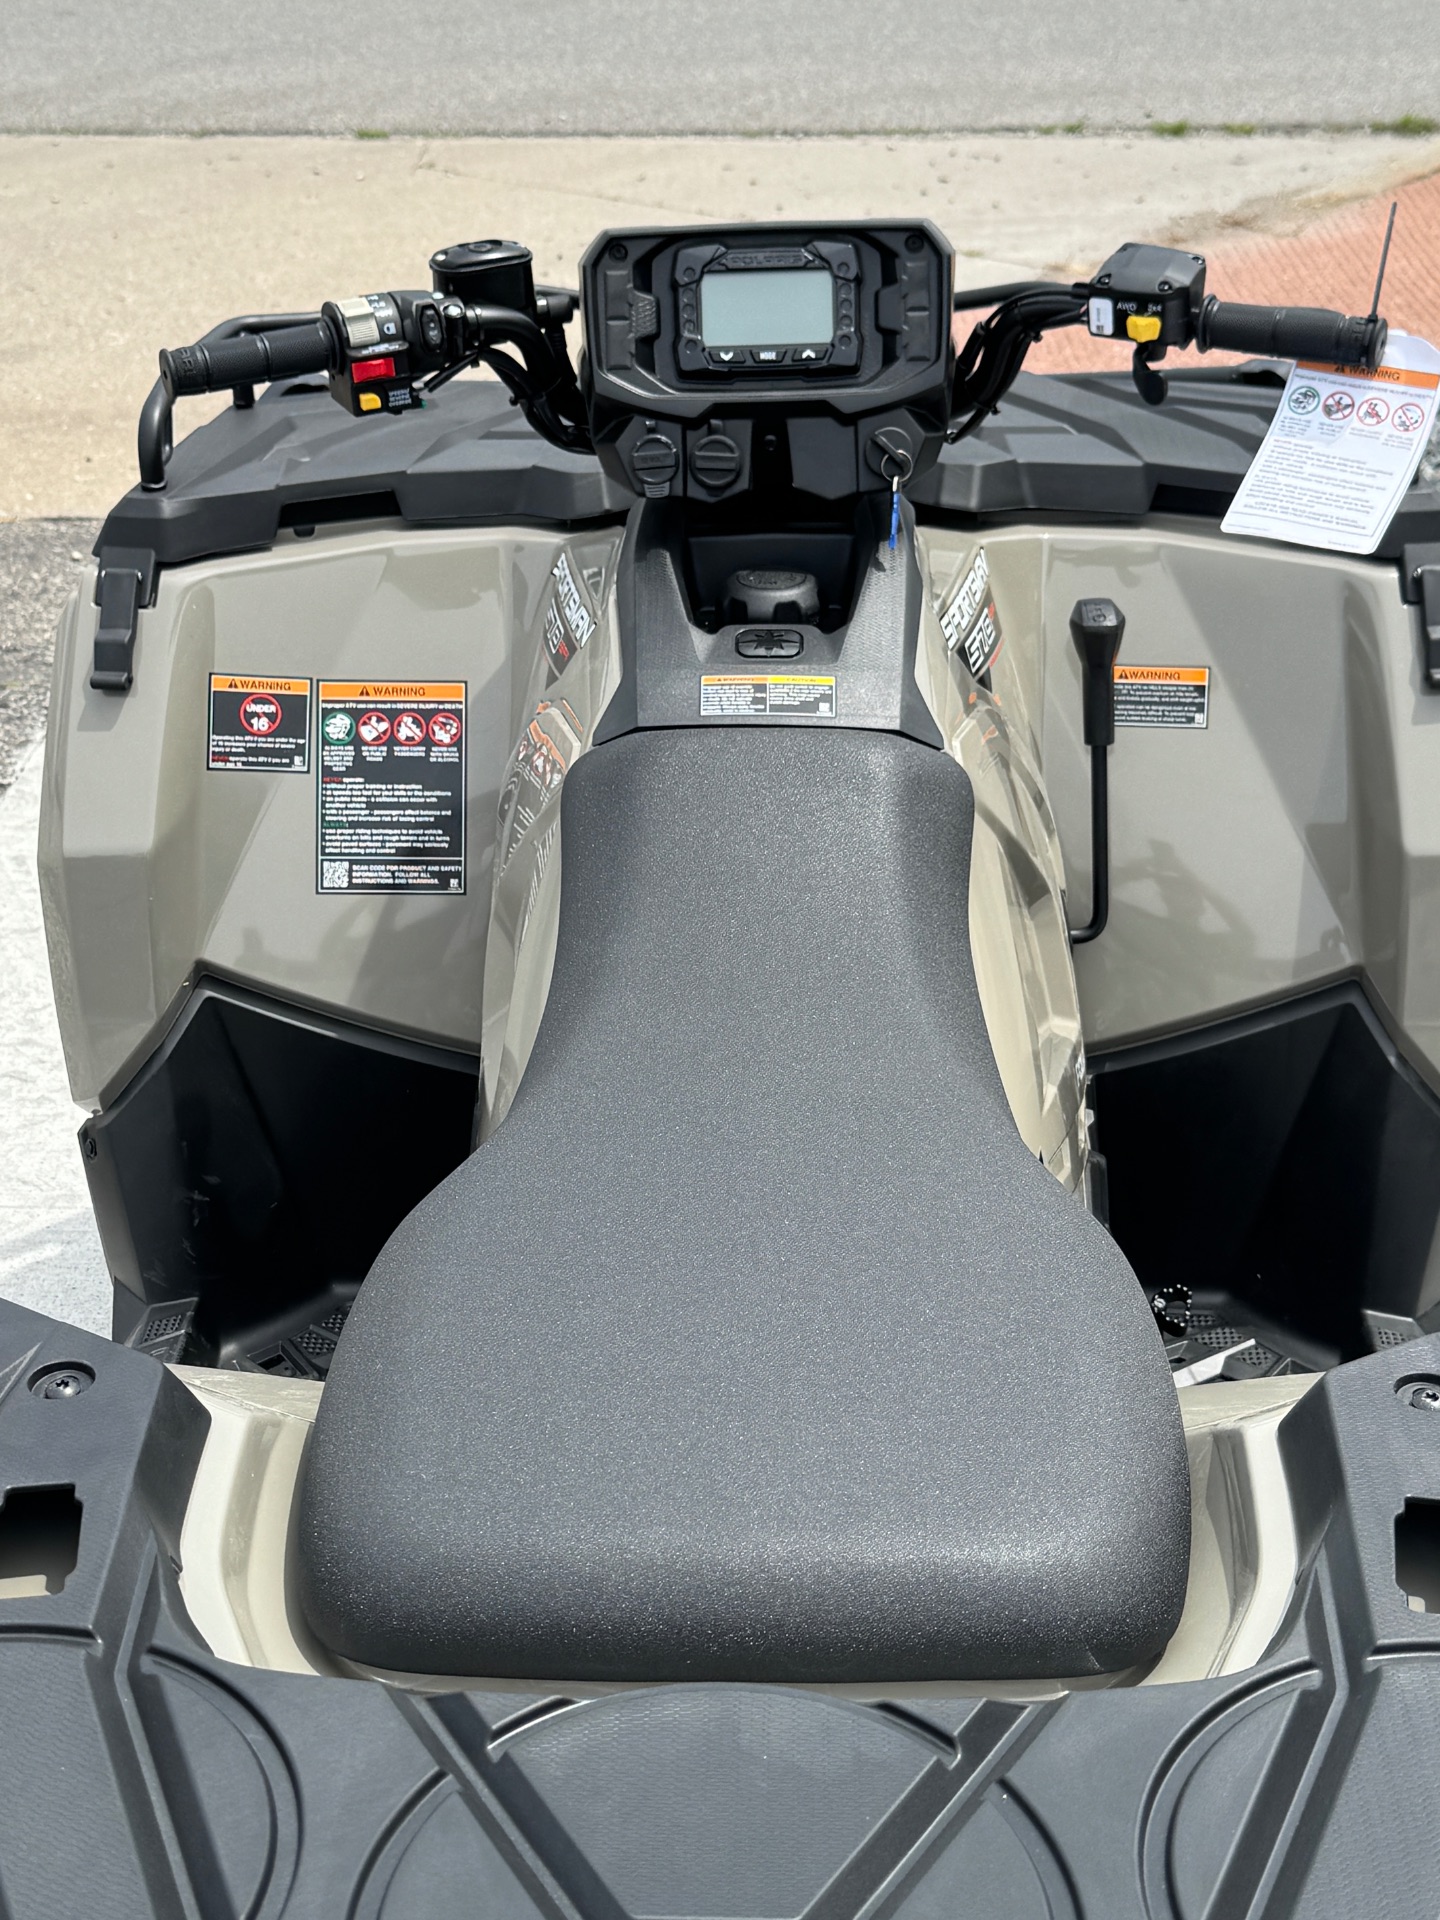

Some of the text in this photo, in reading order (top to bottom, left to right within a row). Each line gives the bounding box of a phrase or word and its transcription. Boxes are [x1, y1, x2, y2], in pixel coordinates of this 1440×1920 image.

[1116, 301, 1137, 311] AWD
[939, 547, 989, 652] SPORTSMAN
[964, 607, 996, 673] 570
[1129, 670, 1181, 681] WARNING
[240, 680, 291, 691] WARNING
[373, 686, 426, 697] WARNING
[246, 703, 276, 714] UNDER
[250, 716, 270, 731] 16
